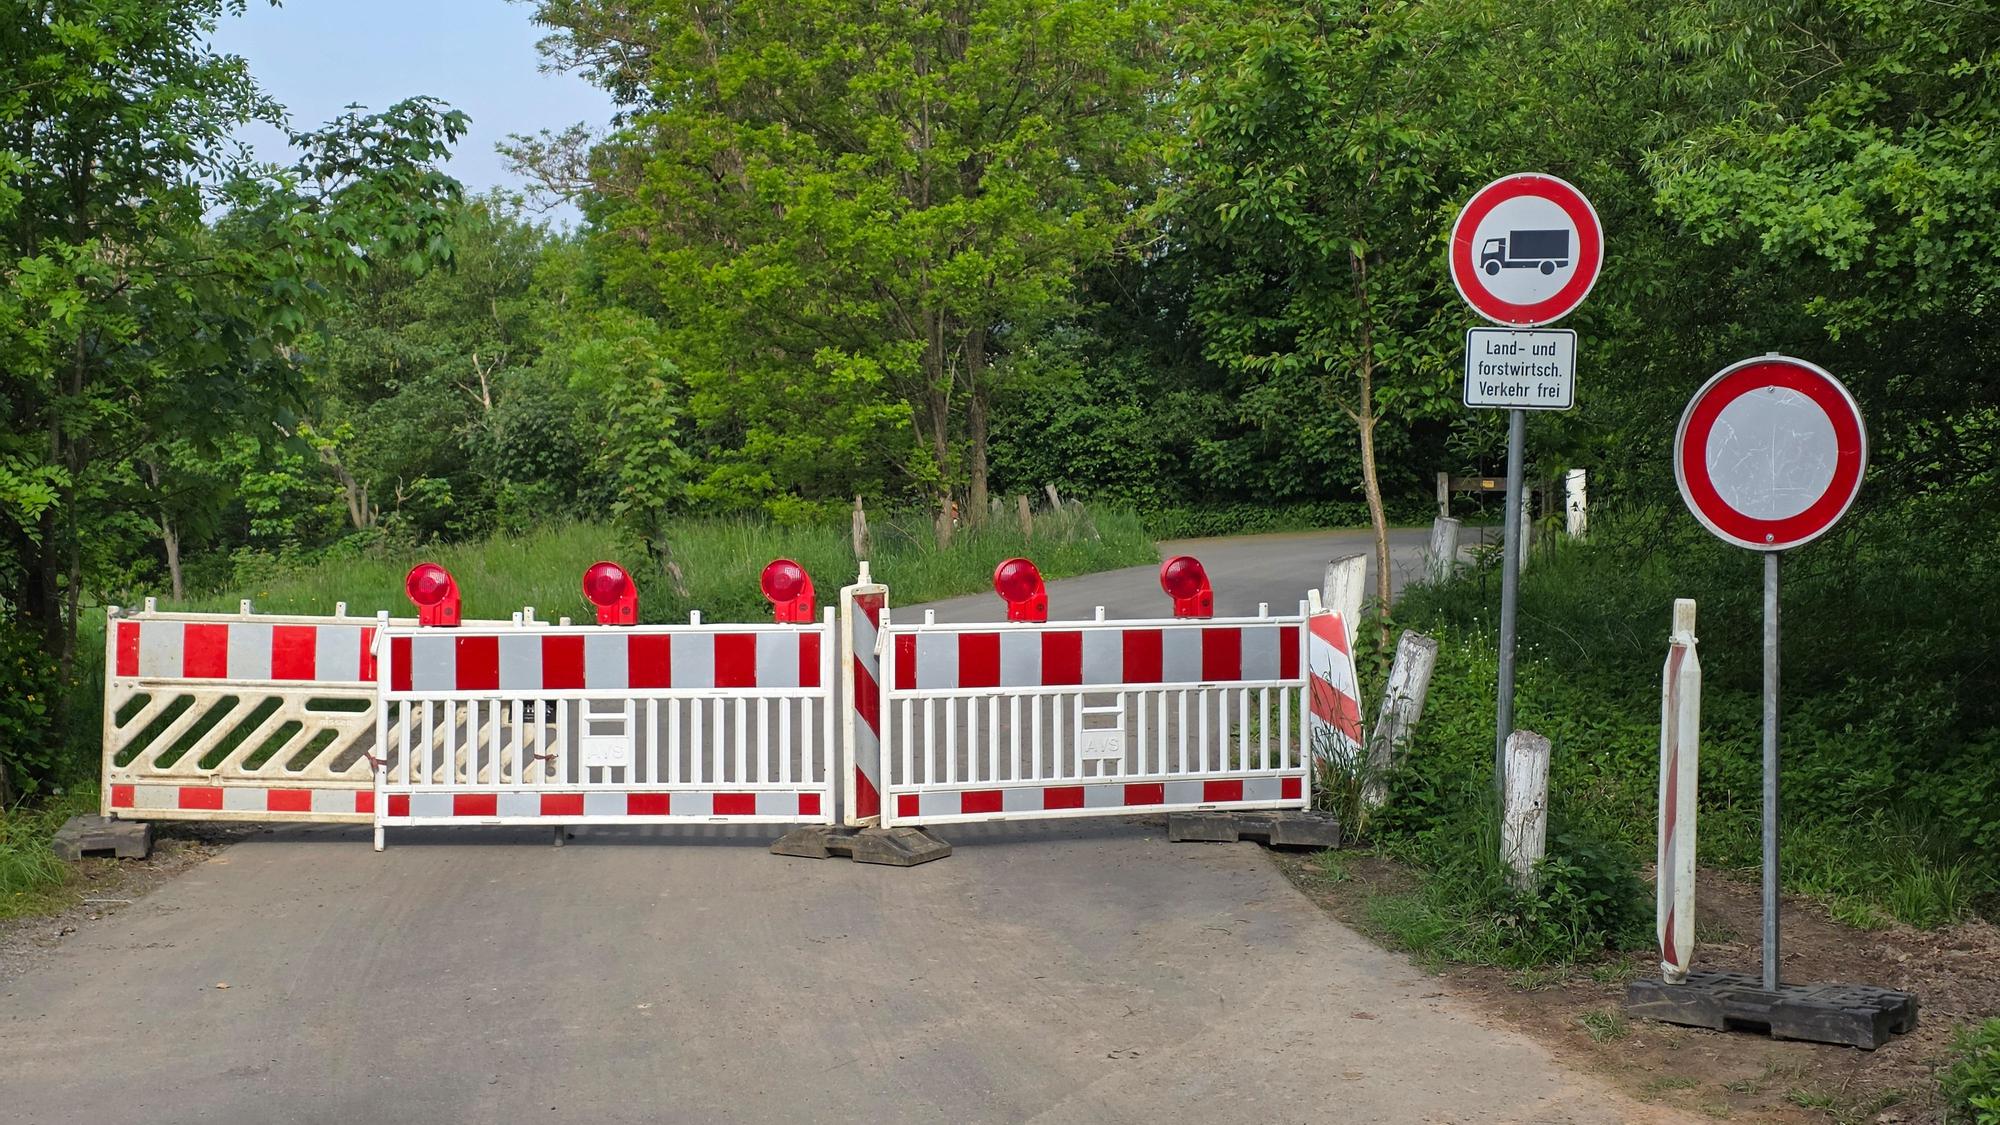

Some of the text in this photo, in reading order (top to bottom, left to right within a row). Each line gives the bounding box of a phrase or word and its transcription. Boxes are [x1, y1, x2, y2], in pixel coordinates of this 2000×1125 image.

[1486, 340, 1556, 356] Land- und
[1478, 360, 1562, 377] forstwirtsch.
[1479, 381, 1560, 398] Verkehr frei
[1084, 736, 1120, 753] AVS
